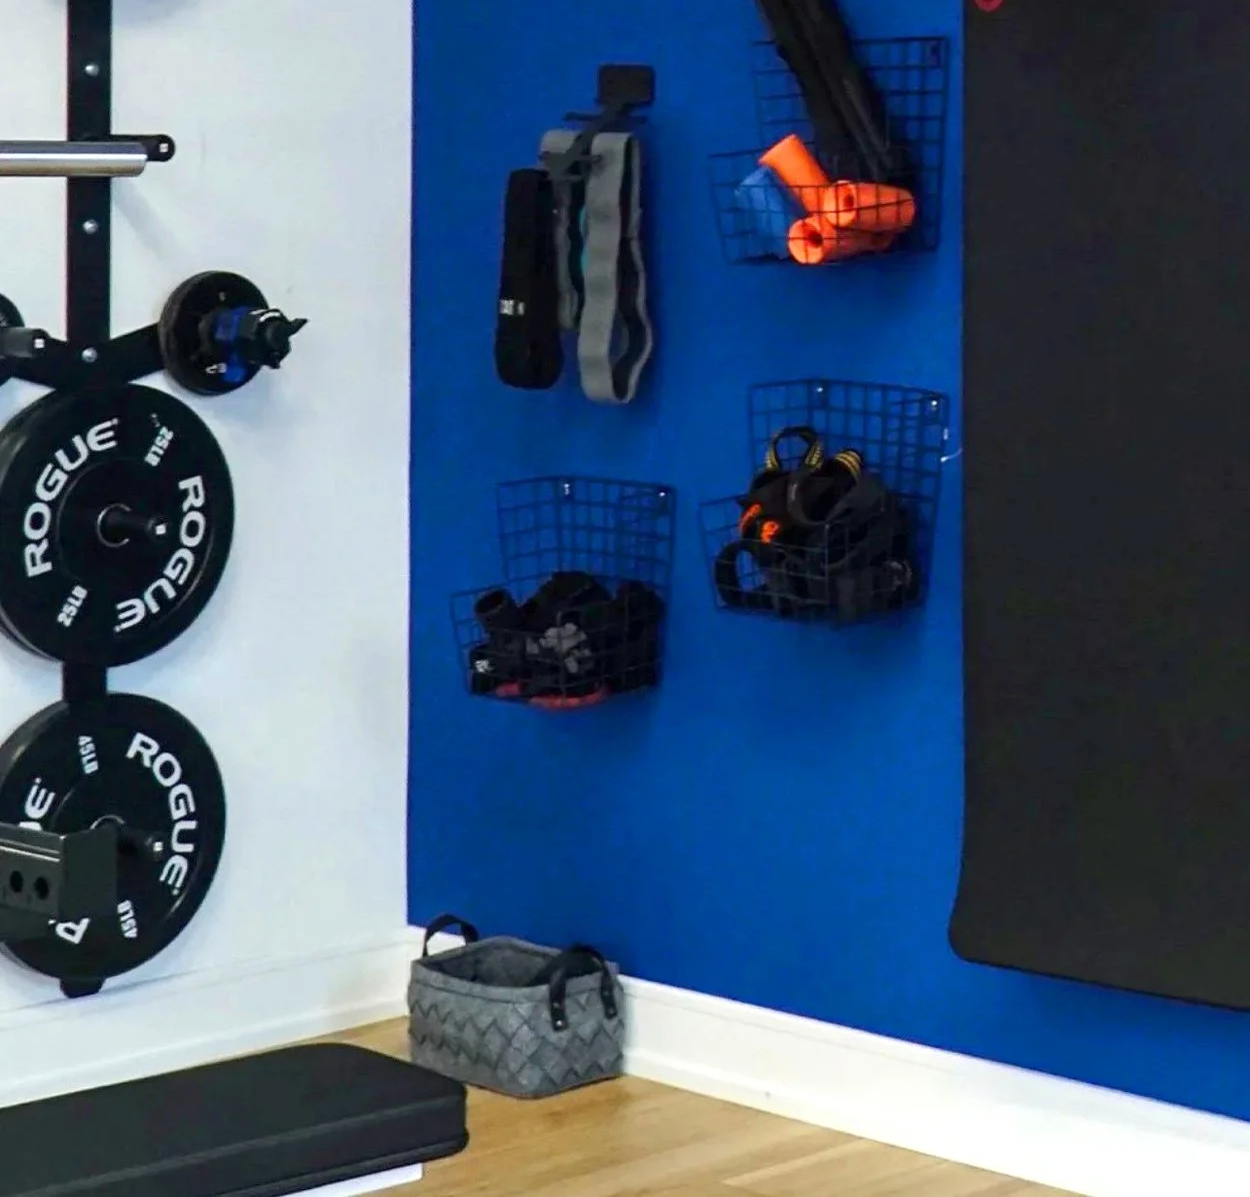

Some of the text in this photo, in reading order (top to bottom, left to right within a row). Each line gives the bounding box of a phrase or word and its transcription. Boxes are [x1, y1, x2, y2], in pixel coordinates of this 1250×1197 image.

[24, 416, 119, 578] ROGUE
[113, 475, 206, 633] ROGUE
[126, 732, 197, 896] ROGUE
